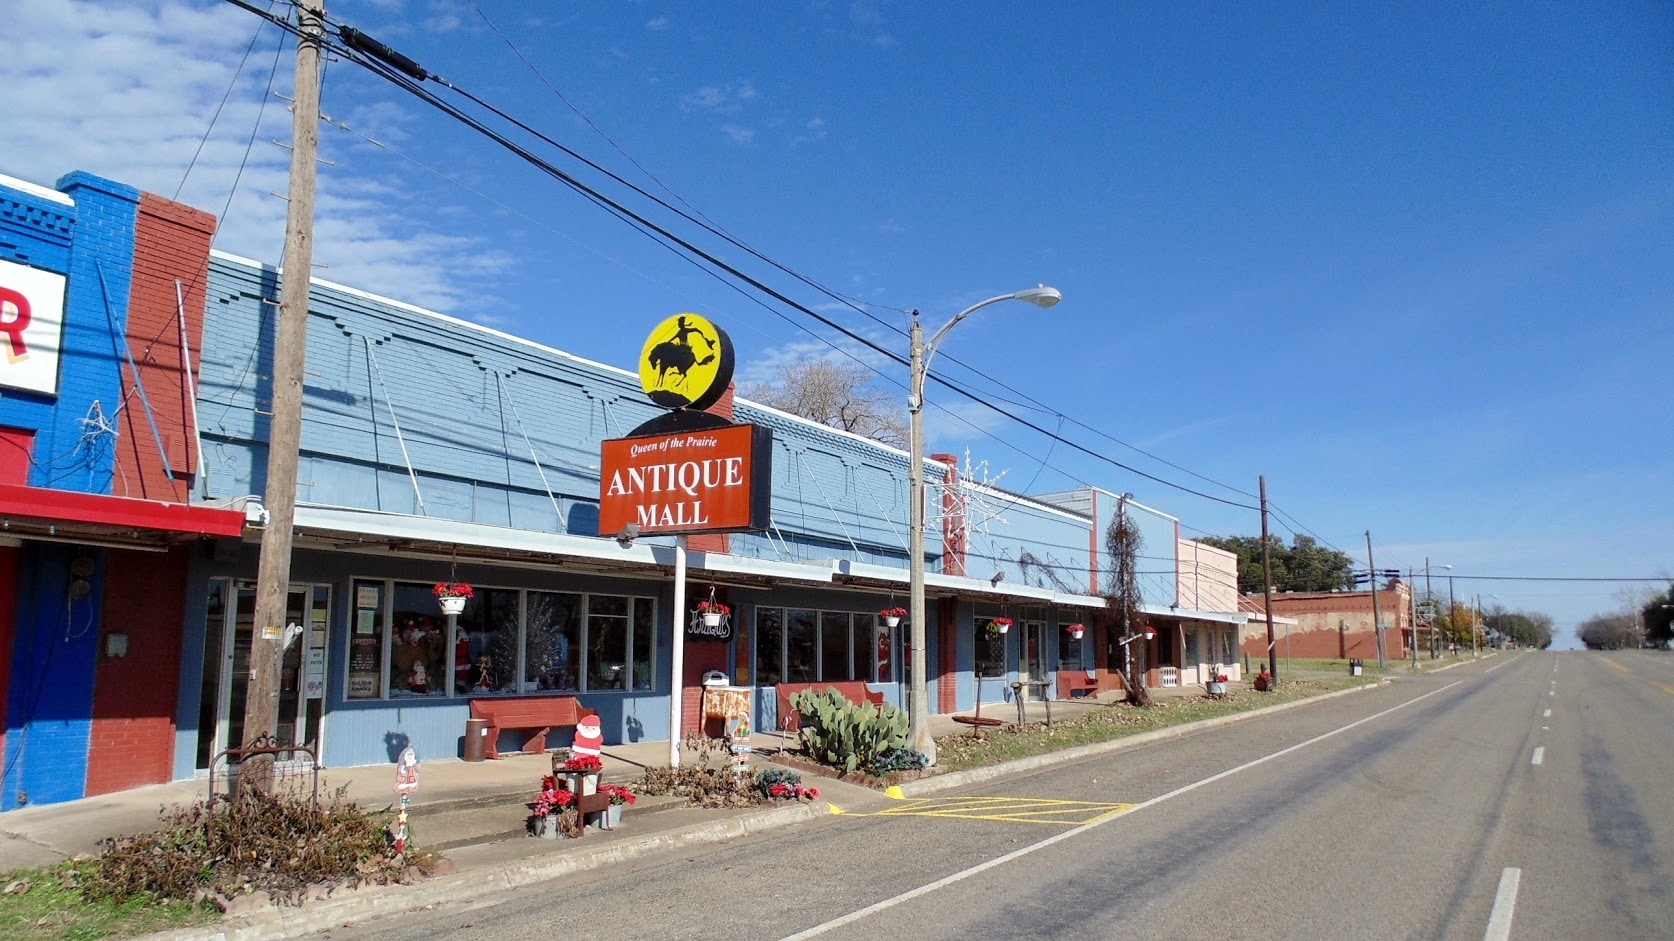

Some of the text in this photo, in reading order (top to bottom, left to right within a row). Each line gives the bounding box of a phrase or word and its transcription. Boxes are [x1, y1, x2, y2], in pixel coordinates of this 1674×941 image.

[0, 286, 31, 358] R
[631, 436, 718, 457] Queen of the Prairie
[607, 457, 743, 496] ANTIQUE
[636, 501, 709, 528] MALL
